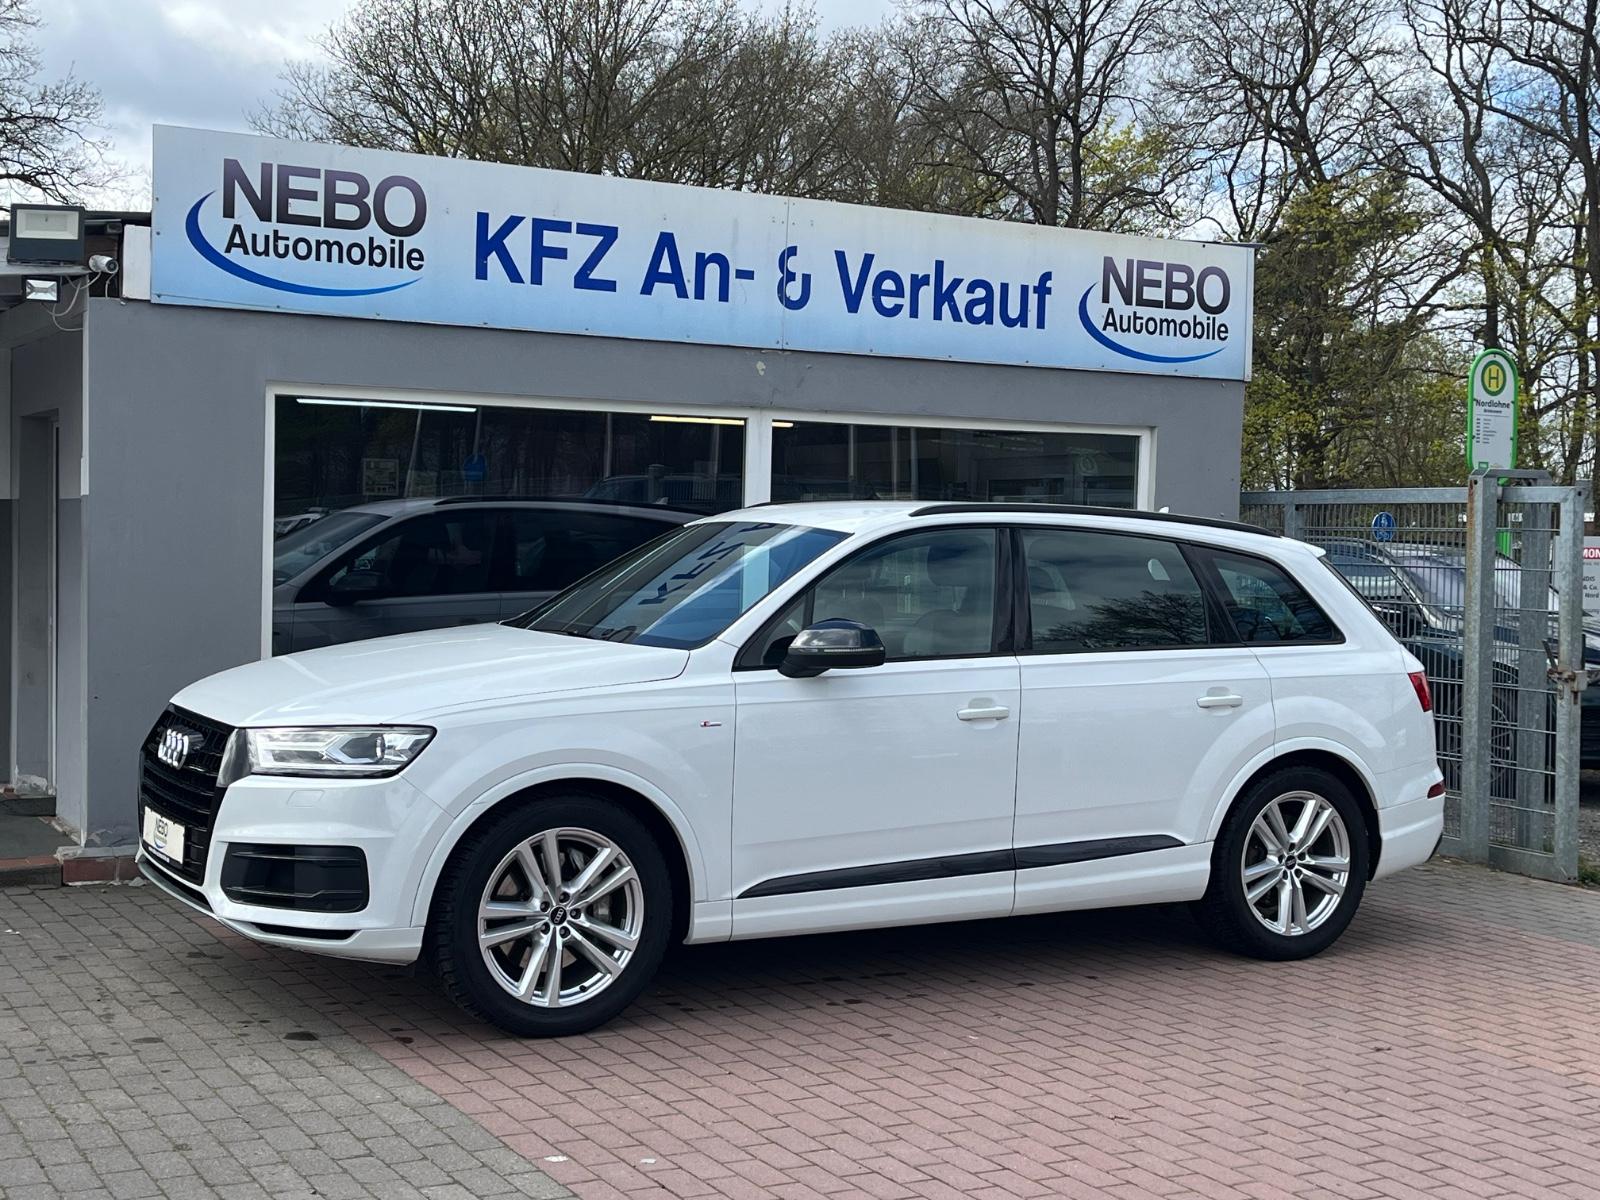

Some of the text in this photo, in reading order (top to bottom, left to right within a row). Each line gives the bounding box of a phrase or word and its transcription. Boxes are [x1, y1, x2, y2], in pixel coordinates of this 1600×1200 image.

[222, 158, 427, 238] NEBO
[224, 223, 425, 272] Automobile
[475, 211, 1053, 330] KFZ An- & Verkauf
[1101, 256, 1230, 315] NEBO
[1103, 307, 1229, 342] Automobile
[1488, 368, 1500, 388] H
[1476, 400, 1510, 408] Nordlohne
